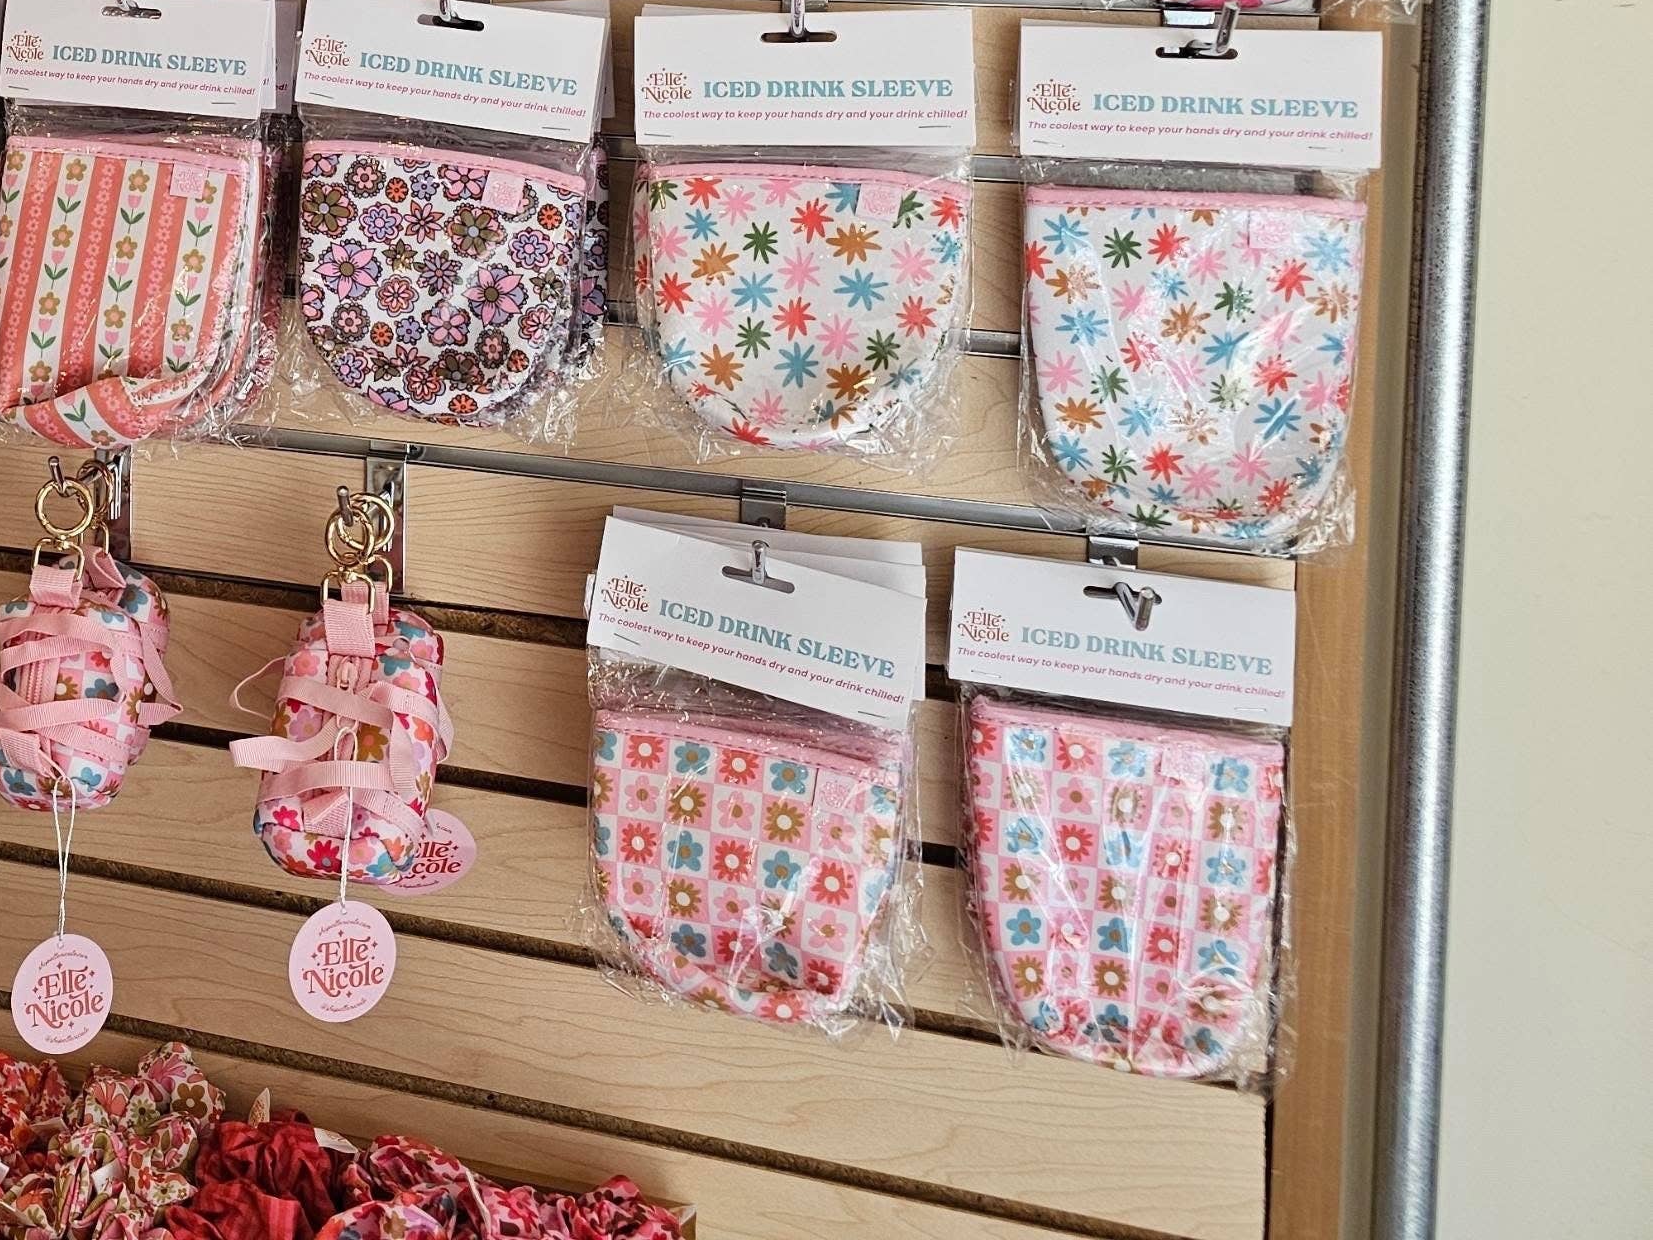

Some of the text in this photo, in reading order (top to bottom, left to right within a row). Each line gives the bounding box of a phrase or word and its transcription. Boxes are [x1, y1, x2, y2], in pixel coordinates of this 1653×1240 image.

[306, 50, 349, 67] Nicole
[314, 39, 346, 53] Elle
[360, 52, 577, 96] ICED DRINK SLEEVE
[704, 79, 953, 99] ICED DRINK SLEEVE
[644, 110, 661, 118] The
[663, 110, 700, 118] coolest
[702, 112, 723, 120] way
[738, 110, 763, 120] keep
[765, 112, 788, 120] your
[791, 110, 822, 118] hands
[825, 110, 843, 120] dry
[846, 110, 867, 118] and
[869, 111, 893, 120] your
[896, 110, 922, 118] drink
[924, 109, 967, 119] chilled!
[1093, 94, 1358, 118] ICED DRINK SLEEVE
[611, 577, 643, 596] Elle
[602, 590, 649, 612] Nicole
[660, 599, 895, 679] ICED DRINK SLEEVE
[1022, 627, 1273, 676] ICED DRINK SLEEVE
[317, 937, 371, 966] Elle
[38, 966, 88, 998] Elle
[303, 963, 384, 997] Nicole
[26, 990, 103, 1028] Nicole
